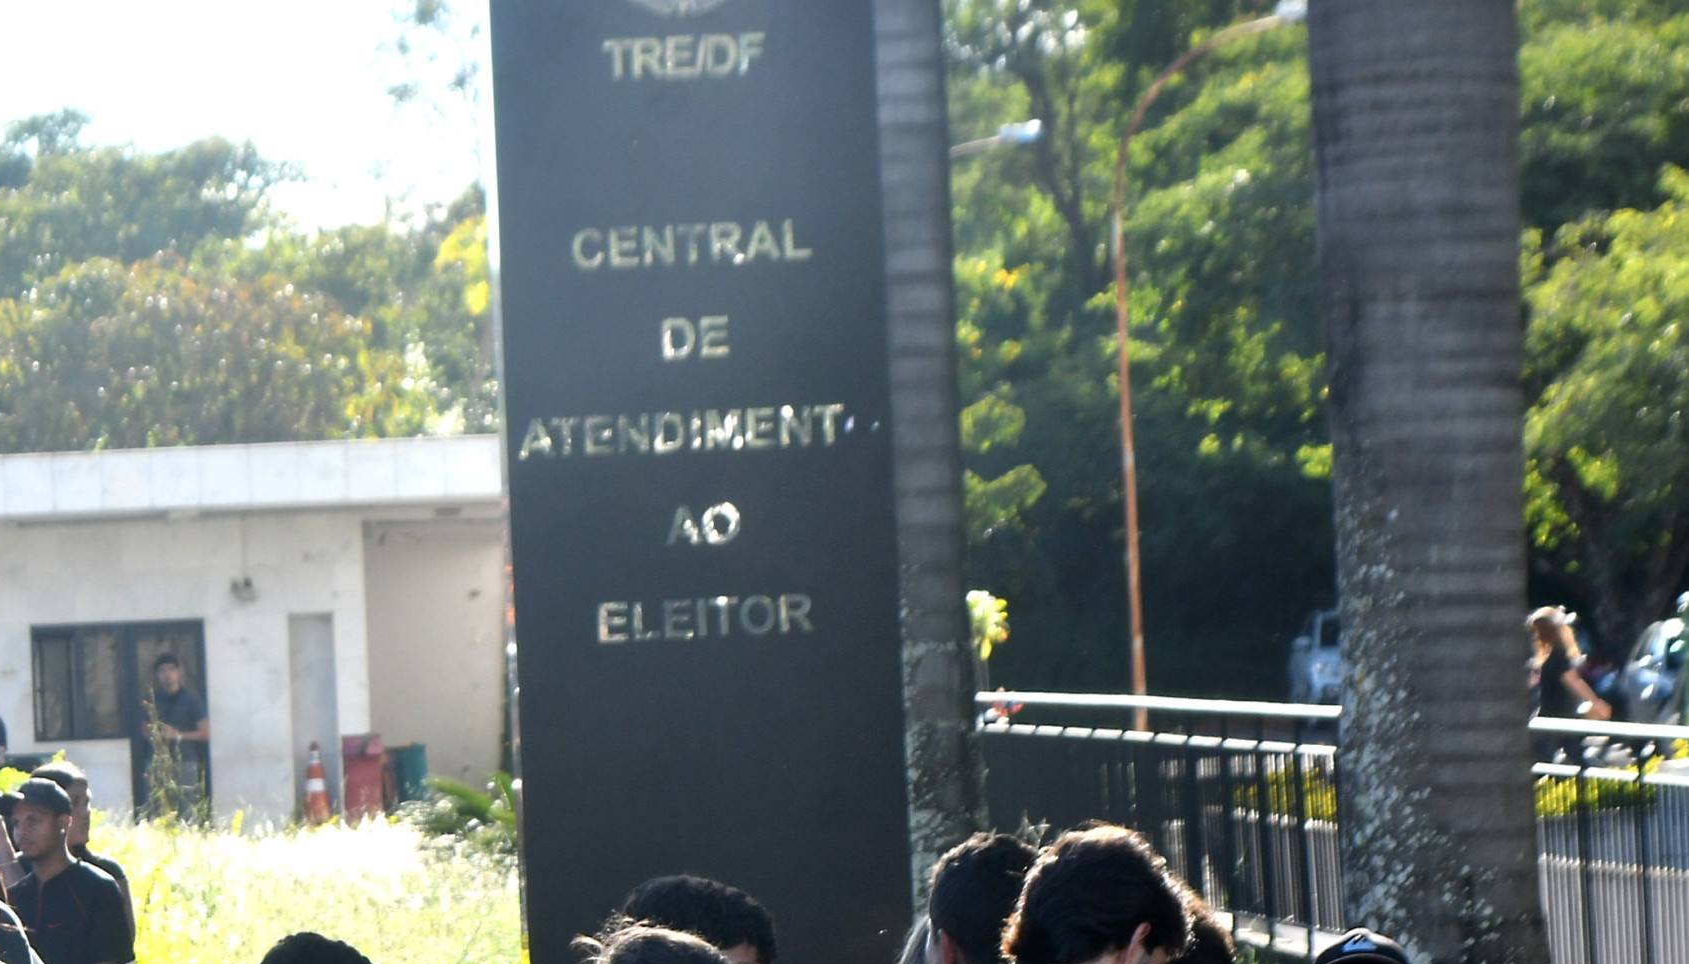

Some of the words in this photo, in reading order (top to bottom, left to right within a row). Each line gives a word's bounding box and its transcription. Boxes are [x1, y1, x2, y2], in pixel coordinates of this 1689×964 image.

[602, 31, 766, 81] TRE/DF
[571, 218, 813, 270] CENTRAL
[660, 314, 731, 362] DE
[518, 403, 881, 460] ATENDIMENT
[666, 501, 742, 546] AO
[596, 594, 815, 644] ELEITOR
